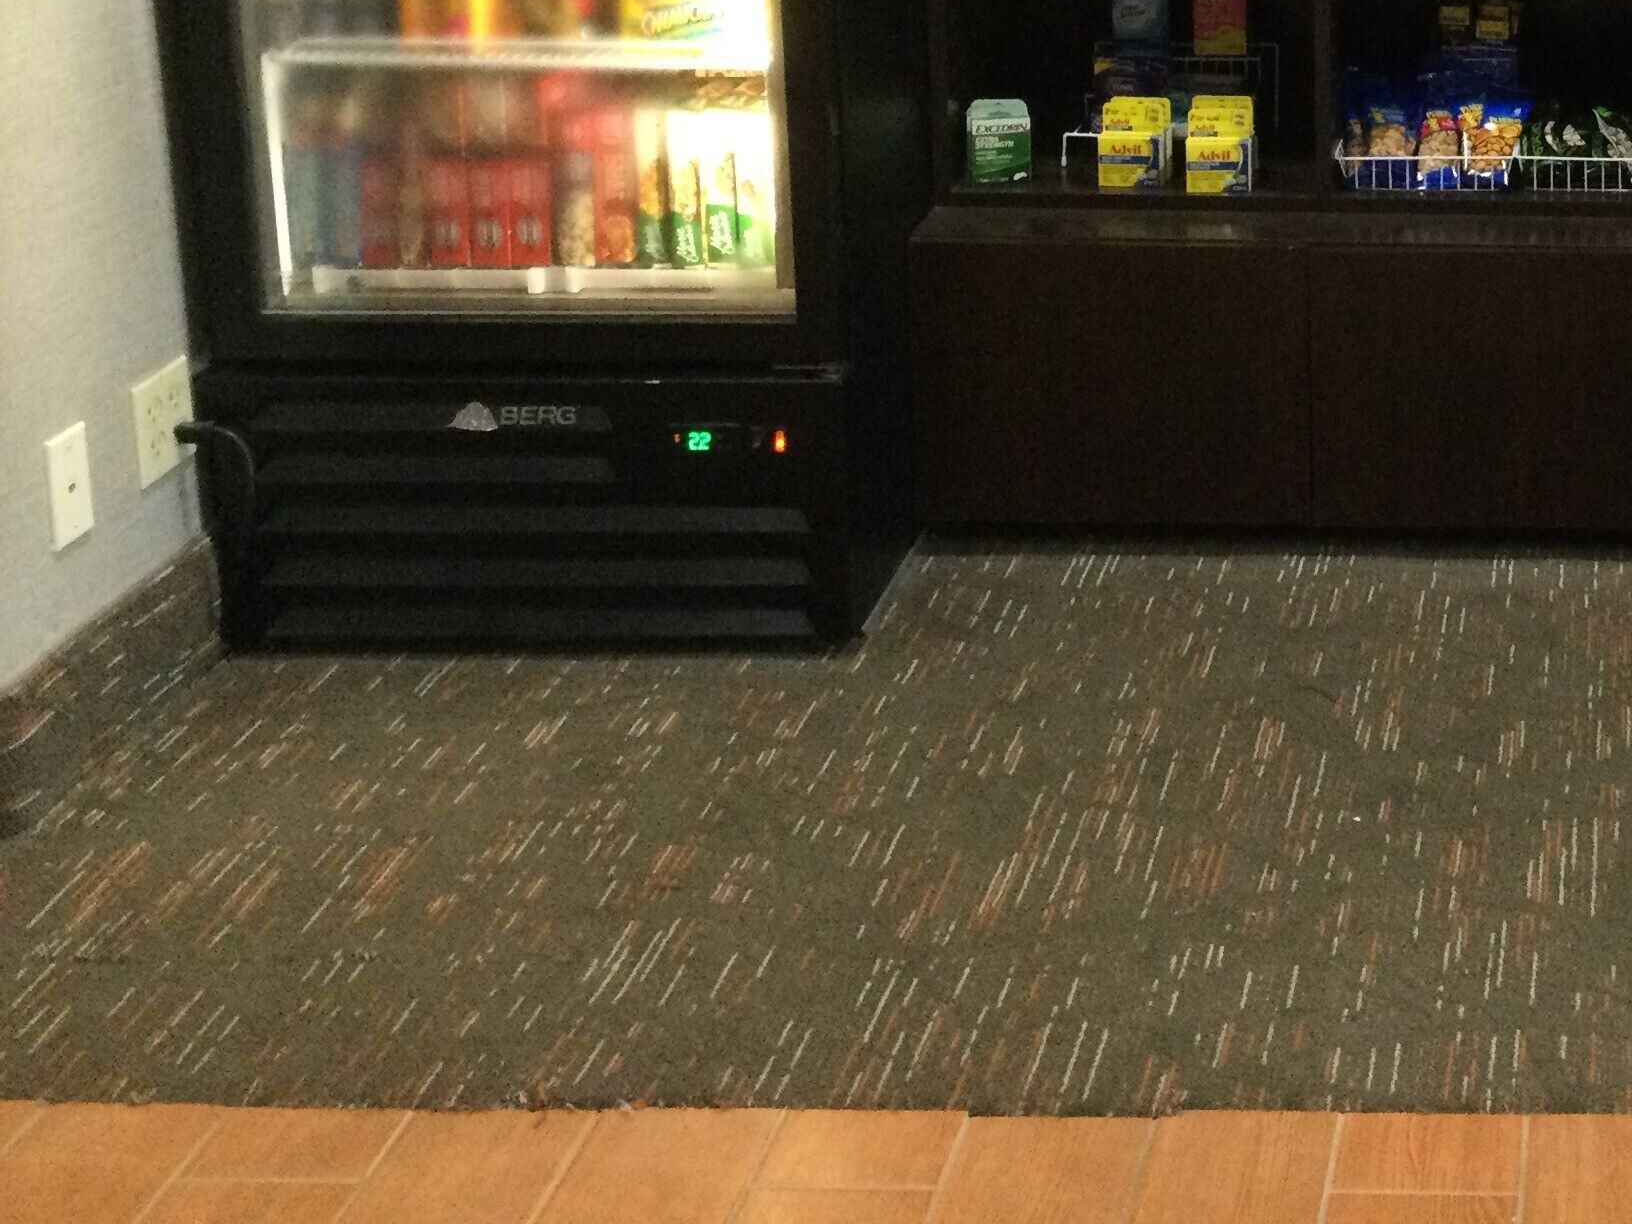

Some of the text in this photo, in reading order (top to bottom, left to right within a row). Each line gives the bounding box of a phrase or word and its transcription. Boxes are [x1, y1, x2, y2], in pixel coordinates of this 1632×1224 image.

[1110, 144, 1142, 155] Advil
[1199, 150, 1231, 161] Advil
[501, 405, 578, 425] BERG
[687, 431, 713, 452] 22
